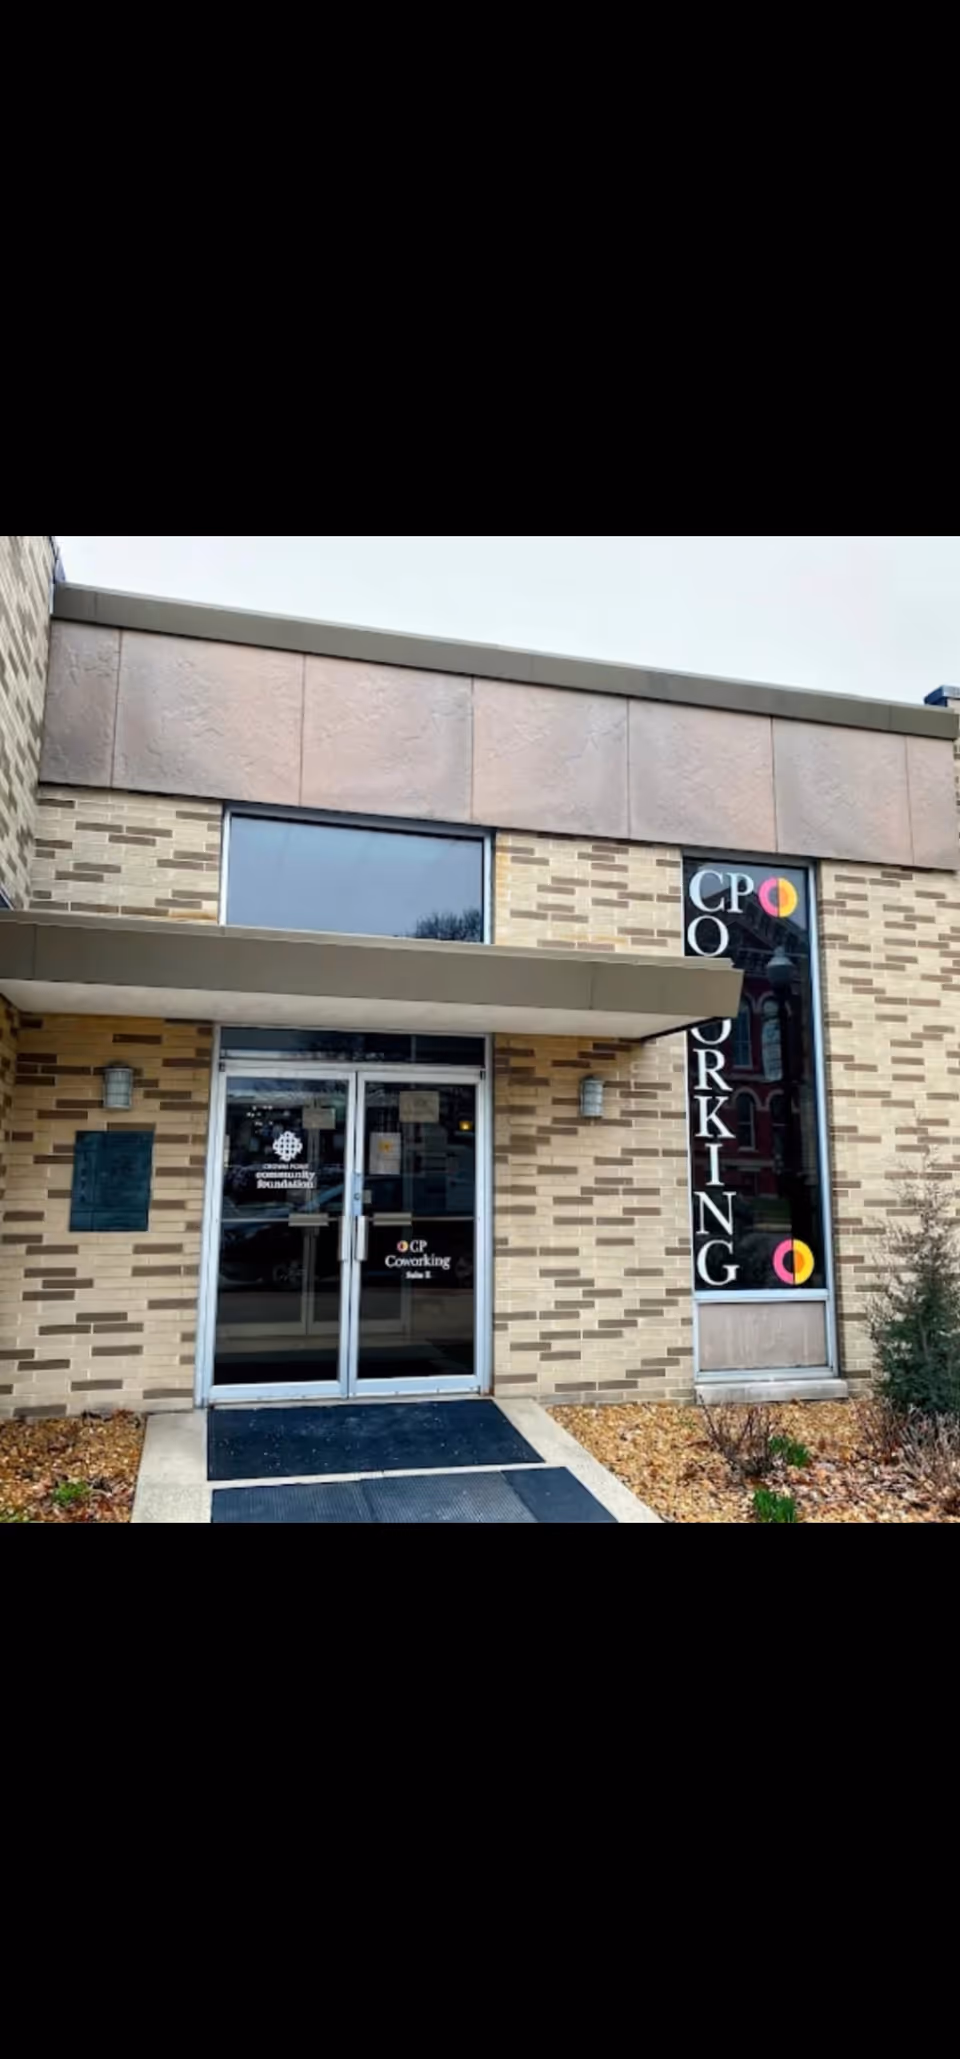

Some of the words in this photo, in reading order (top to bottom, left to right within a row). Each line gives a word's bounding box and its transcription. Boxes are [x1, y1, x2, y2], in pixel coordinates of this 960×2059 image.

[688, 869, 754, 913] CP
[256, 1171, 316, 1181] community
[257, 1179, 315, 1189] foundation
[410, 1240, 427, 1253] CP
[385, 1253, 451, 1270] Coworking
